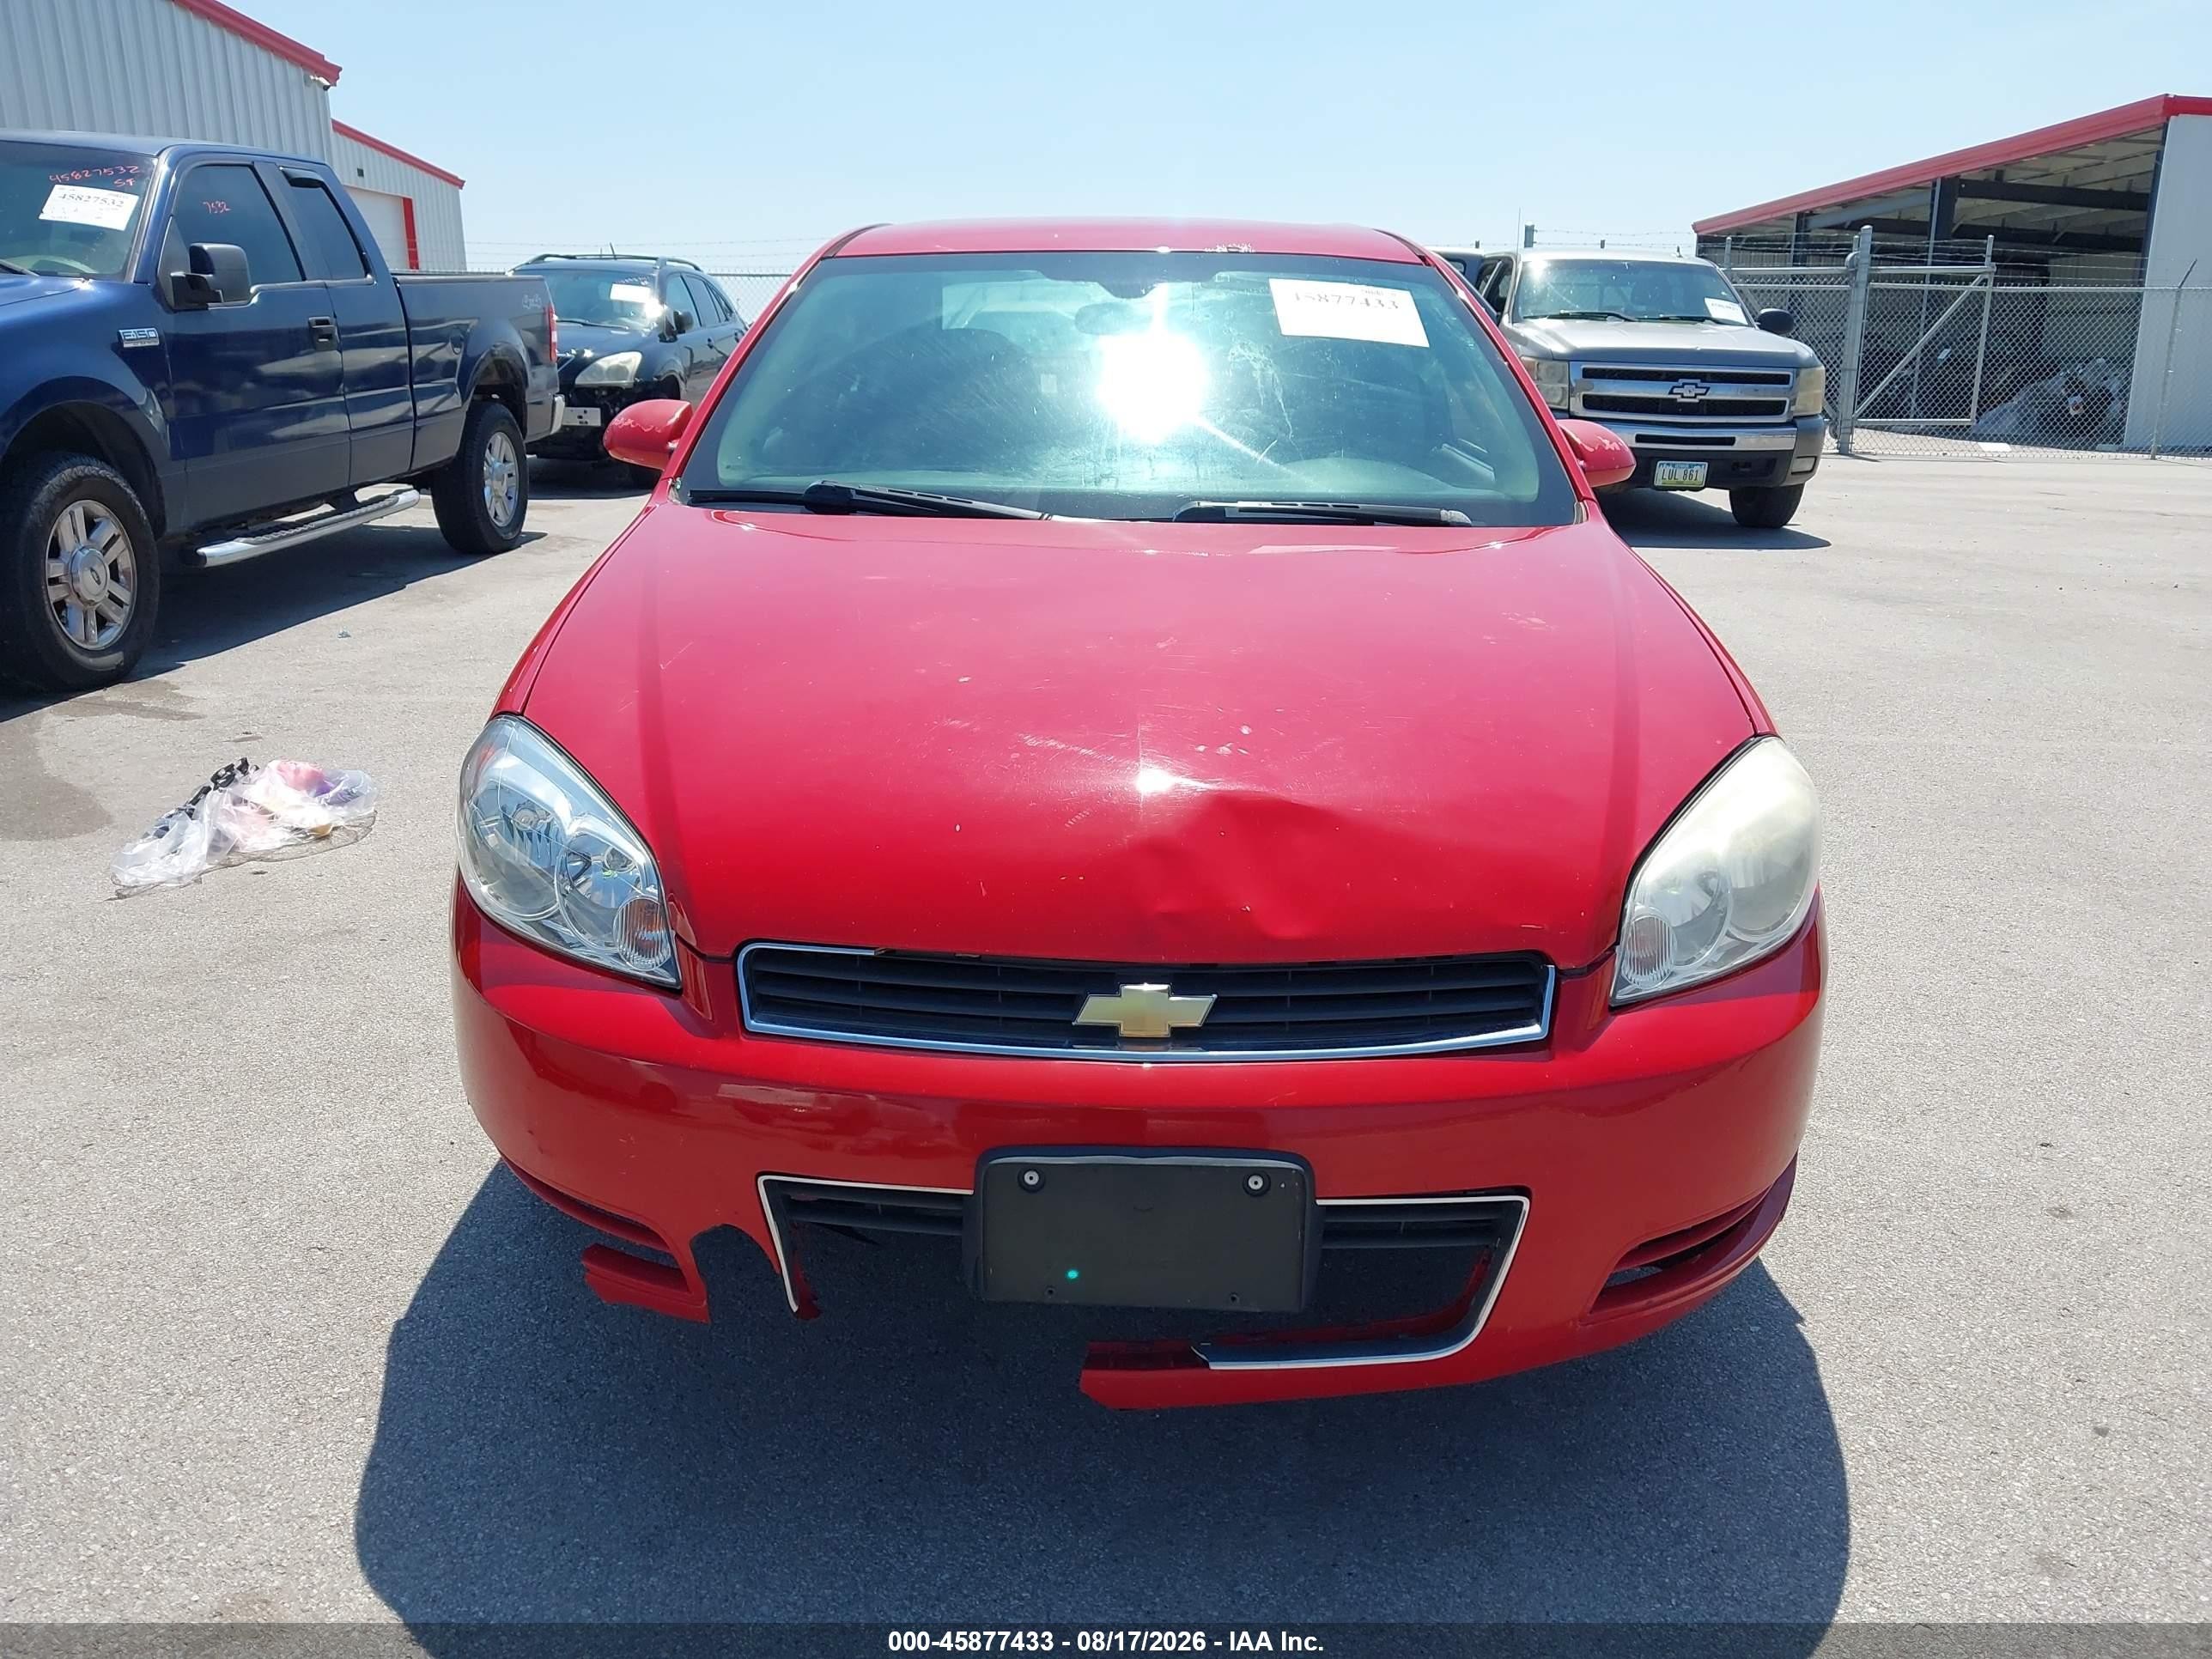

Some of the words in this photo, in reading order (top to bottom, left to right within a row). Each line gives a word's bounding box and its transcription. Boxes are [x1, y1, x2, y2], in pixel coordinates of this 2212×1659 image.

[49, 165, 139, 183] 45827532
[58, 193, 125, 208] 45827532
[1662, 468, 1679, 481] LUL
[1683, 469, 1698, 481] 861
